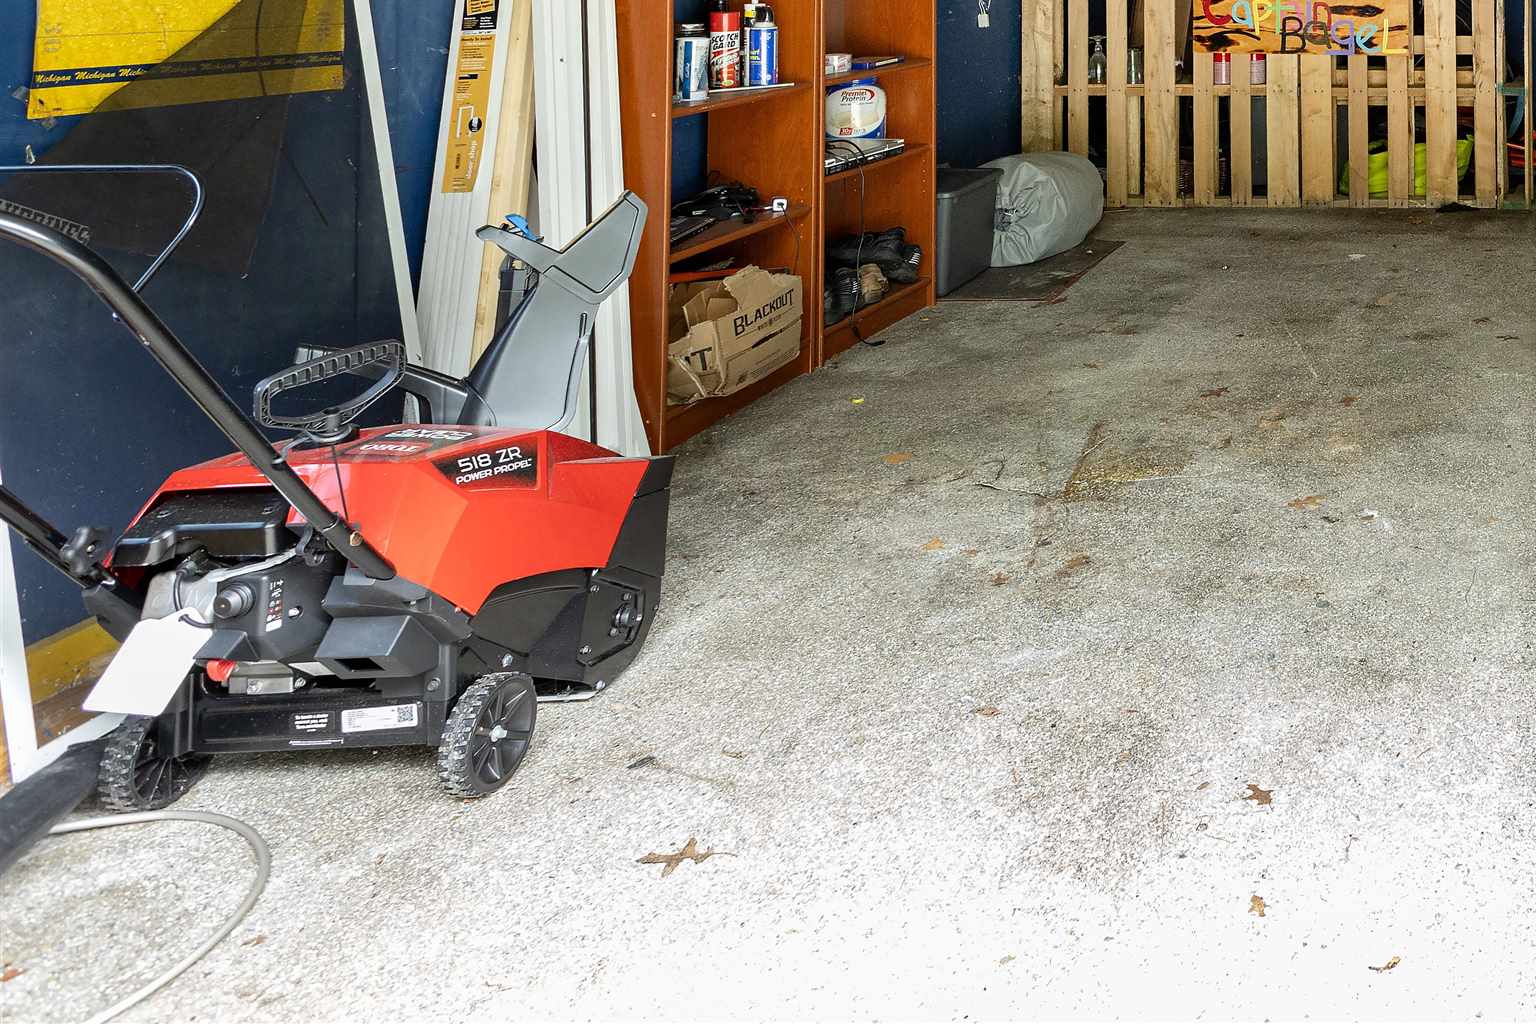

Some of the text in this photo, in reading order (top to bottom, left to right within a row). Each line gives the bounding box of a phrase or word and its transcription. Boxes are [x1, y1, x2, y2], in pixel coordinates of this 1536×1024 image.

[711, 32, 739, 44] SCOTCH
[713, 40, 736, 50] GARD
[75, 68, 117, 81] Michigan
[840, 89, 868, 97] Premier
[841, 95, 867, 103] Protein
[733, 288, 795, 337] BLACKOUT
[457, 446, 523, 473] 518 ZR
[455, 468, 493, 485] POWER
